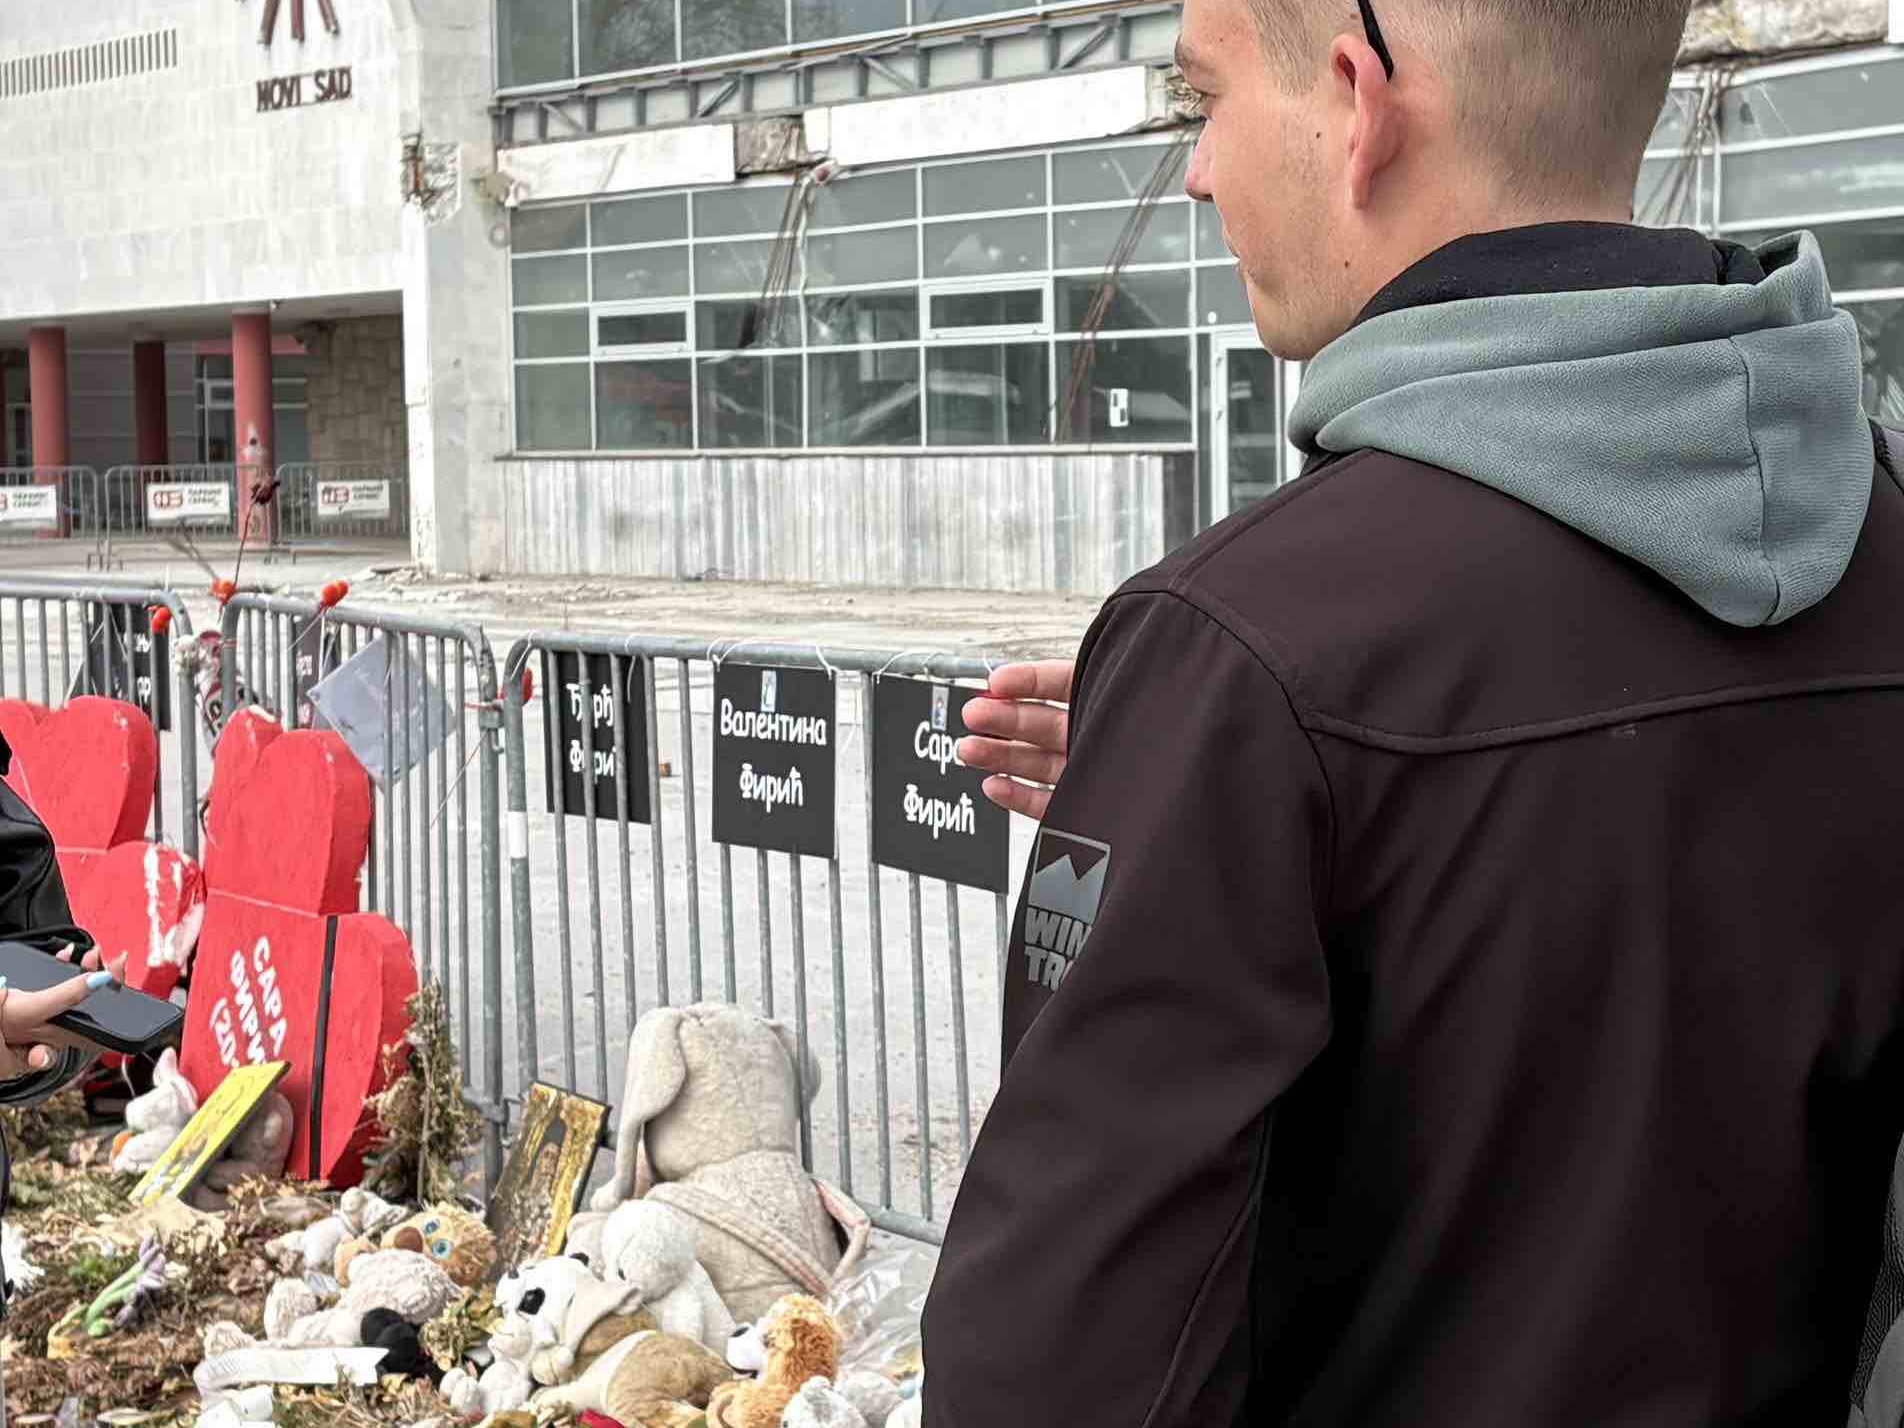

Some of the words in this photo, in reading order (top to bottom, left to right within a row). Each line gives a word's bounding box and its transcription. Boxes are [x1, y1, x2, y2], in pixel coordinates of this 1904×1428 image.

[256, 75, 301, 113] NOVI
[313, 66, 353, 103] SAD
[720, 698, 827, 746] Валентина
[739, 763, 804, 813] Фирић
[903, 783, 976, 840] Фирић
[230, 949, 266, 1066] ФИРИ
